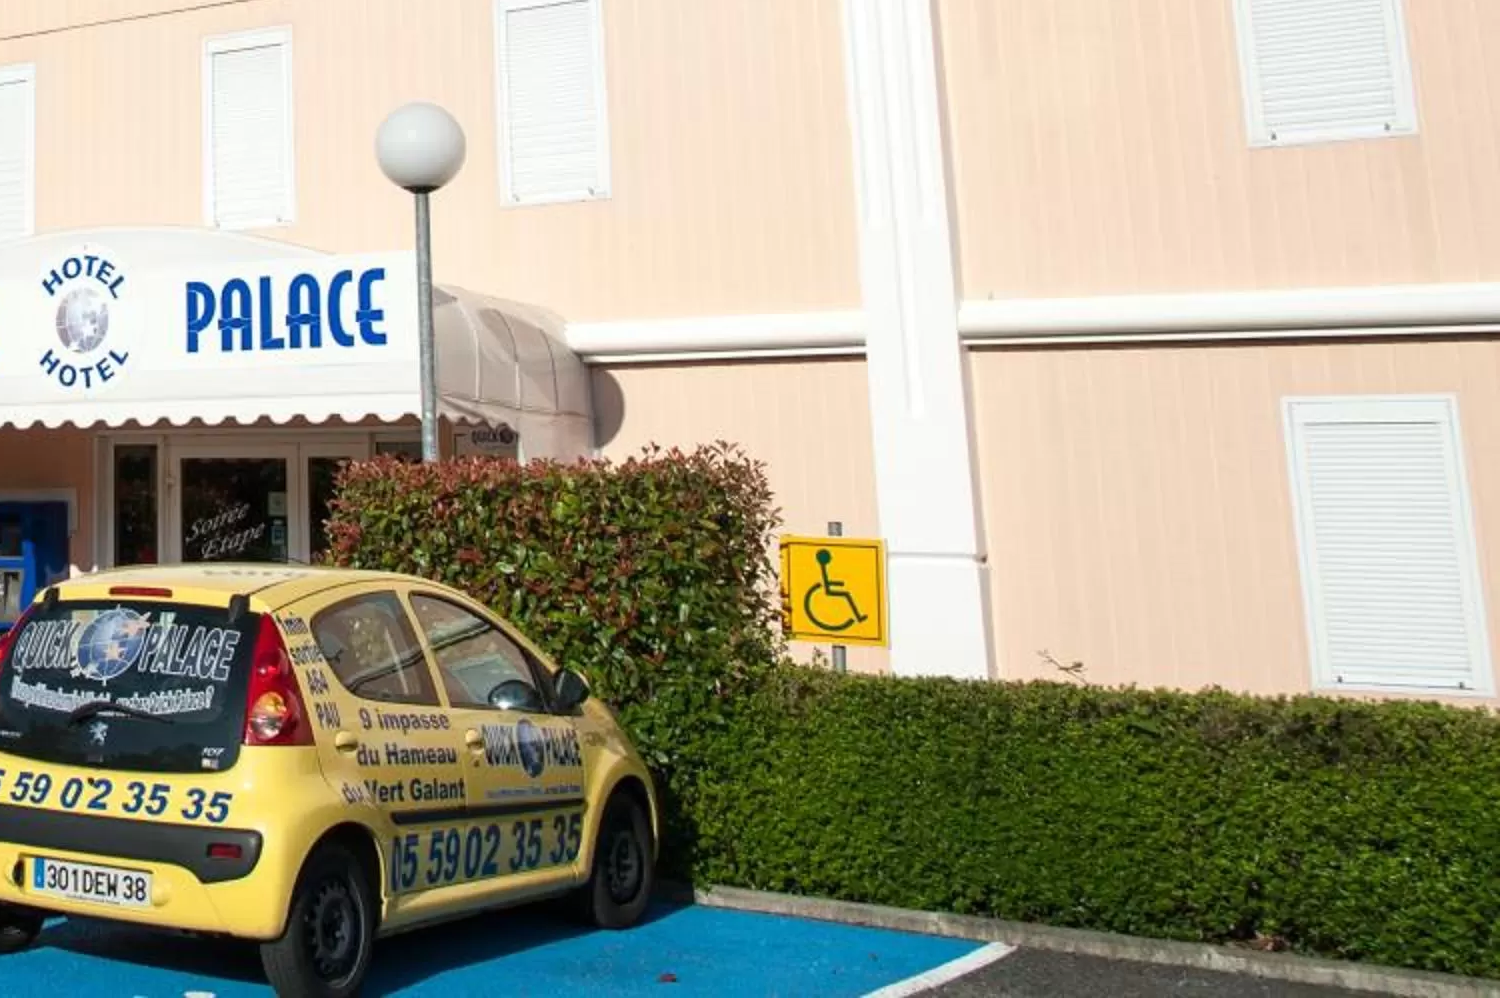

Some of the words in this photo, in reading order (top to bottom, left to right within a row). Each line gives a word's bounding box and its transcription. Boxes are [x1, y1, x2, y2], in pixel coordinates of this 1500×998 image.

[42, 255, 124, 299] HOTEL
[186, 268, 387, 353] PALACE
[40, 349, 129, 389] HOTEL
[11, 620, 80, 674] QUICK
[137, 624, 240, 682] PALACE
[314, 701, 340, 731] PAU
[359, 707, 372, 730] 9
[375, 708, 450, 735] impasse
[357, 743, 380, 766] du
[384, 742, 457, 765] Hameau
[10, 771, 52, 804] 59
[60, 777, 113, 810] 02
[122, 781, 170, 816] 35
[181, 788, 232, 823] 35
[364, 778, 405, 803] Vert
[409, 777, 465, 801] Galant
[426, 827, 461, 883] 59
[464, 824, 501, 878] 02
[509, 818, 543, 870] 35
[549, 813, 582, 864] 35
